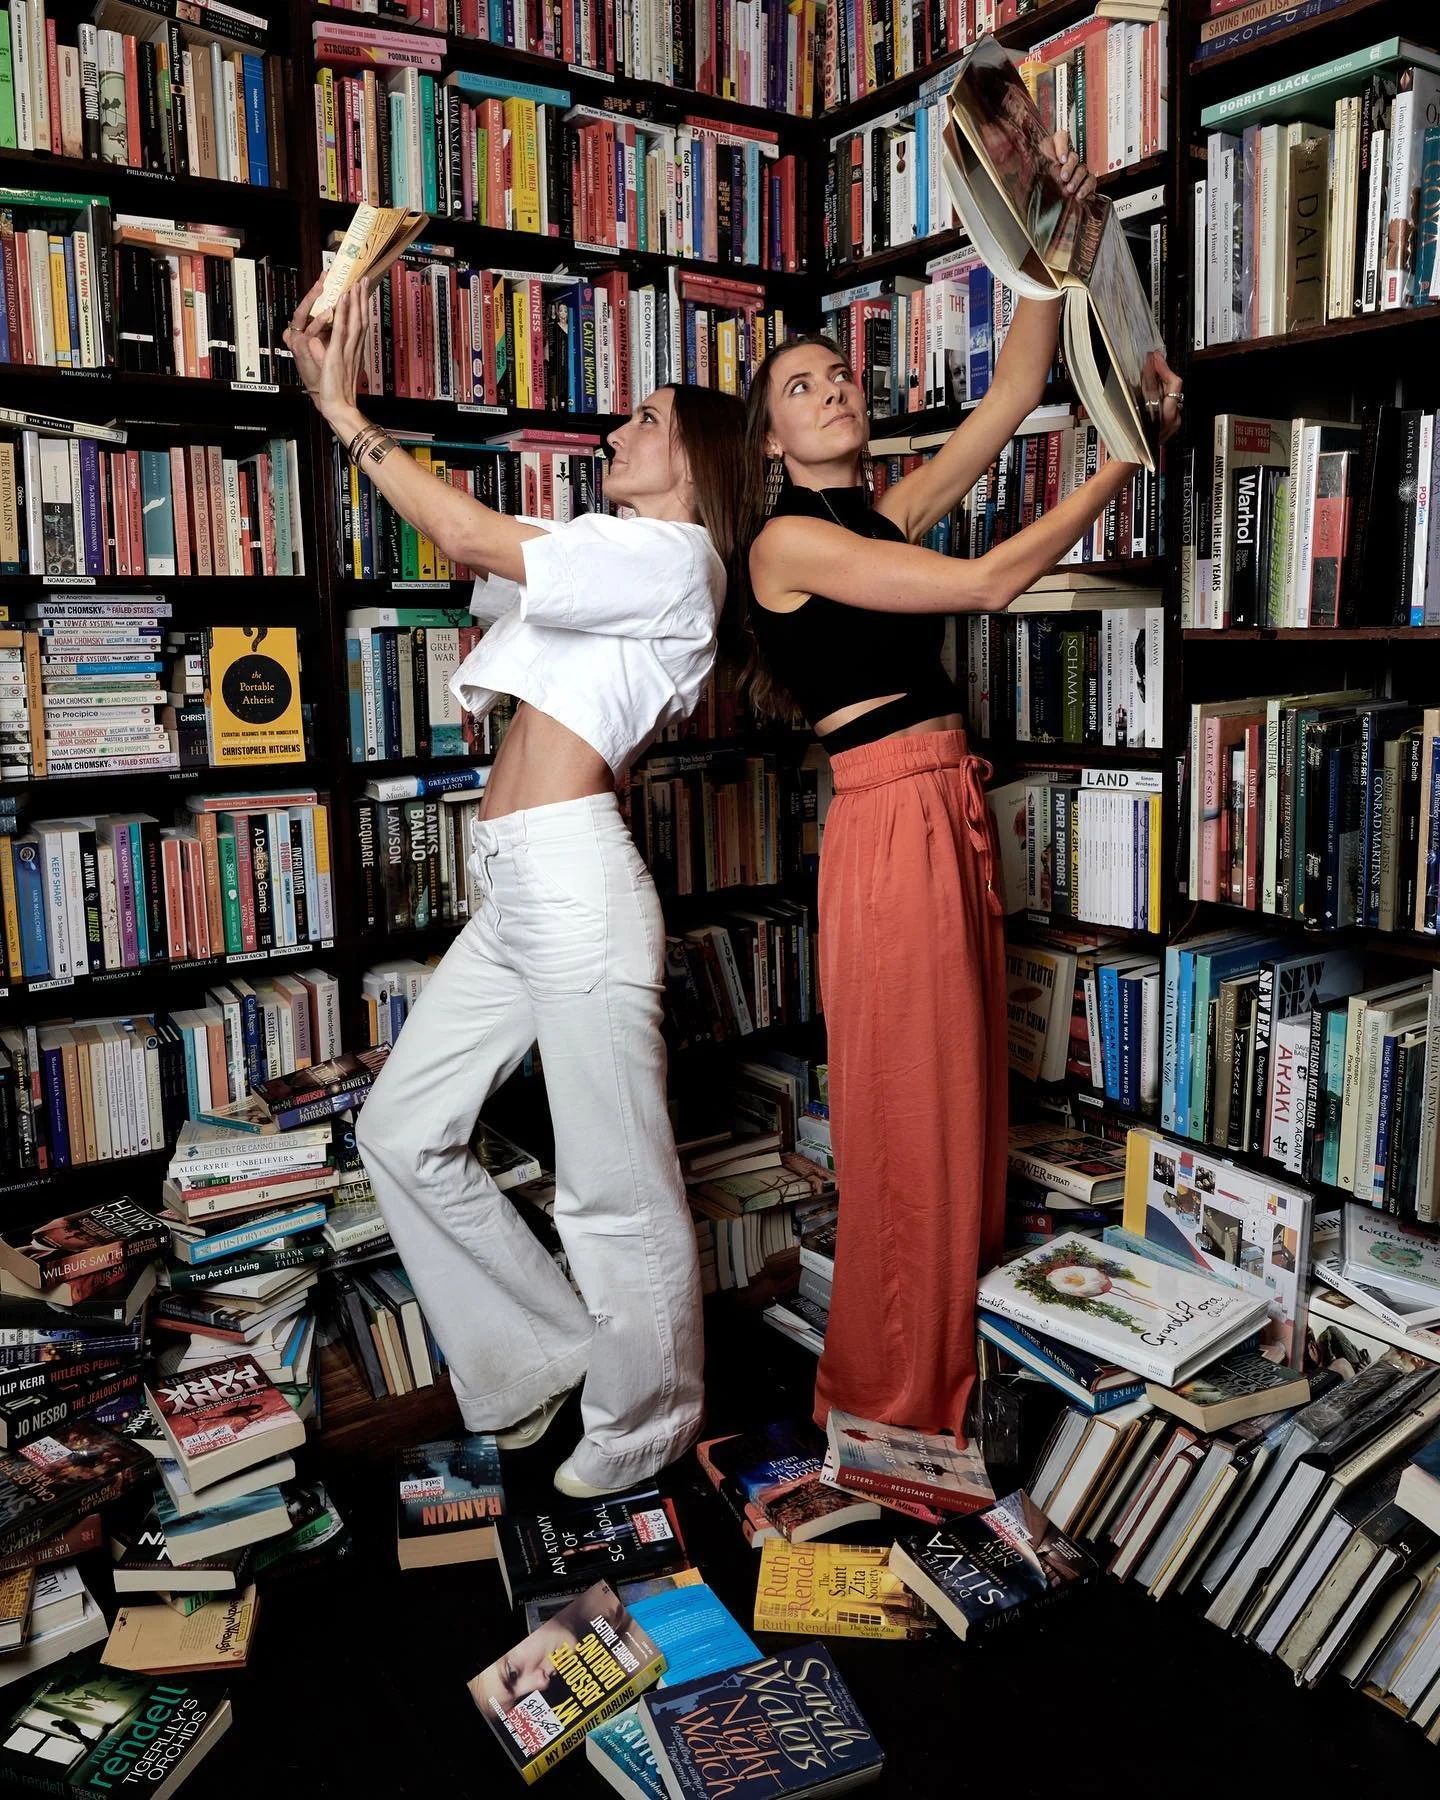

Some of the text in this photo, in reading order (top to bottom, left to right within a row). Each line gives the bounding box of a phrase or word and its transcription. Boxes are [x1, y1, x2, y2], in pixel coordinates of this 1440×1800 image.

[1208, 7, 1267, 37] SAVING MONA
[323, 43, 362, 57] STRONGER
[408, 54, 423, 64] BELL
[1219, 62, 1353, 114] DORRIT BLACK unseen forces
[525, 107, 536, 192] NINTH STREET WOMEN
[126, 169, 176, 182] PHILOSOPHY A-Z
[78, 235, 89, 298] HOW WIN
[6, 283, 17, 334] PHILOSOPHY
[532, 285, 541, 333] WITNESS
[644, 294, 652, 348] BECOMING
[950, 295, 965, 314] THE
[583, 321, 595, 396] CATHY NEWMAN
[619, 307, 628, 396] DRAWING POWER
[700, 335, 708, 368] WORD
[1048, 435, 1059, 485] WITNESS
[1074, 432, 1086, 488] PIERS MORGAN
[1291, 429, 1300, 471] NORMAN
[1, 469, 13, 532] RATIONALISTS
[580, 482, 588, 505] WRIGHT
[976, 474, 987, 517] MOSUL
[1236, 474, 1256, 544] Warhol
[1212, 455, 1224, 591] ANDY WARHOL THE LIFE YEARS
[217, 544, 226, 567] ROSES
[43, 606, 154, 615] NOAM FAILED STATES
[430, 642, 458, 652] GREAT
[434, 653, 455, 663] WAR
[239, 682, 275, 692] Portable
[251, 670, 262, 679] the
[1066, 637, 1078, 705] SCHAMA
[46, 710, 99, 720] The Precipice
[241, 696, 275, 705] Atheist
[1088, 677, 1097, 731] JOHN SIMPSON
[222, 744, 301, 756] CHRISTOPHER HITCHENS
[1410, 740, 1420, 781] David Smith
[428, 774, 473, 788] GREAT SOUTH
[442, 782, 463, 791] LAND
[1086, 773, 1129, 787] LAND
[358, 807, 374, 868] MACQUARIE
[386, 806, 402, 865] LAWSON
[410, 809, 427, 862] BANJO
[425, 803, 439, 855] BANKS
[1055, 793, 1066, 886] PAPER EMPERORS
[1371, 776, 1384, 885] CONRAD MARTENS
[51, 856, 62, 907] KEEP SHARP
[255, 838, 268, 913] Delicate Game
[291, 847, 305, 895] OVERLOADED
[83, 852, 101, 943] JIM KWIK LIMITLESS
[125, 910, 133, 933] BOOK
[49, 978, 73, 988] MILLER
[1027, 960, 1055, 988] TRUTH
[1166, 979, 1175, 1009] SLIM
[267, 1011, 277, 1047] staring
[327, 1007, 335, 1037] Weirdest
[1223, 990, 1235, 1063] ANSEL ADAMS
[1308, 1010, 1322, 1100] INFRA REALISM KATE
[1274, 1044, 1293, 1123] ARAKI
[299, 1107, 332, 1123] PATTERSON
[1294, 1097, 1305, 1159] LOOK AGAIN
[179, 1154, 295, 1175] ALEC RYRIE UNBELIEVERS
[277, 1140, 298, 1150] HOLD
[43, 1248, 124, 1281] WILBUR SMITH
[189, 1262, 260, 1283] The Act Living
[274, 1249, 303, 1261] FRANK
[274, 1256, 305, 1269] TALLIS
[1314, 1268, 1340, 1290] BAUHAUS
[1140, 1294, 1222, 1346] Grandiflora
[1380, 1311, 1401, 1328] TASCHEN
[20, 1374, 45, 1392] KERR
[1053, 1353, 1076, 1378] MORRIS
[14, 1402, 68, 1440] JO NESBO
[769, 1454, 798, 1471] From
[785, 1455, 820, 1475] Stars
[845, 1472, 934, 1500] SISTERS RESISTANCE
[422, 1495, 503, 1526] RANKIN
[537, 1514, 567, 1575] ANATOMY
[564, 1530, 578, 1548] OF
[597, 1502, 625, 1562] SCANDAL
[763, 1554, 791, 1599] Ruth
[787, 1545, 817, 1617] Rendell
[818, 1572, 828, 1589] The
[829, 1565, 848, 1601] Saint
[848, 1569, 867, 1601] Zita
[869, 1567, 883, 1601] Society
[920, 1548, 972, 1599] DANIEL
[926, 1531, 1006, 1606] SILVA
[761, 1618, 841, 1635] Ruth Rendell
[548, 1641, 605, 1708] ABSOLUTE
[576, 1632, 626, 1691] DARLING
[545, 1685, 635, 1768] MY ABSOLUTE DARLING
[559, 1699, 584, 1728] MY
[738, 1656, 827, 1771] Waters
[784, 1657, 871, 1759] Sarah
[90, 1686, 189, 1789] rendell
[122, 1698, 199, 1784] TIGERLILY'S
[147, 1709, 207, 1781] ORCHIDS
[710, 1694, 785, 1791] Night
